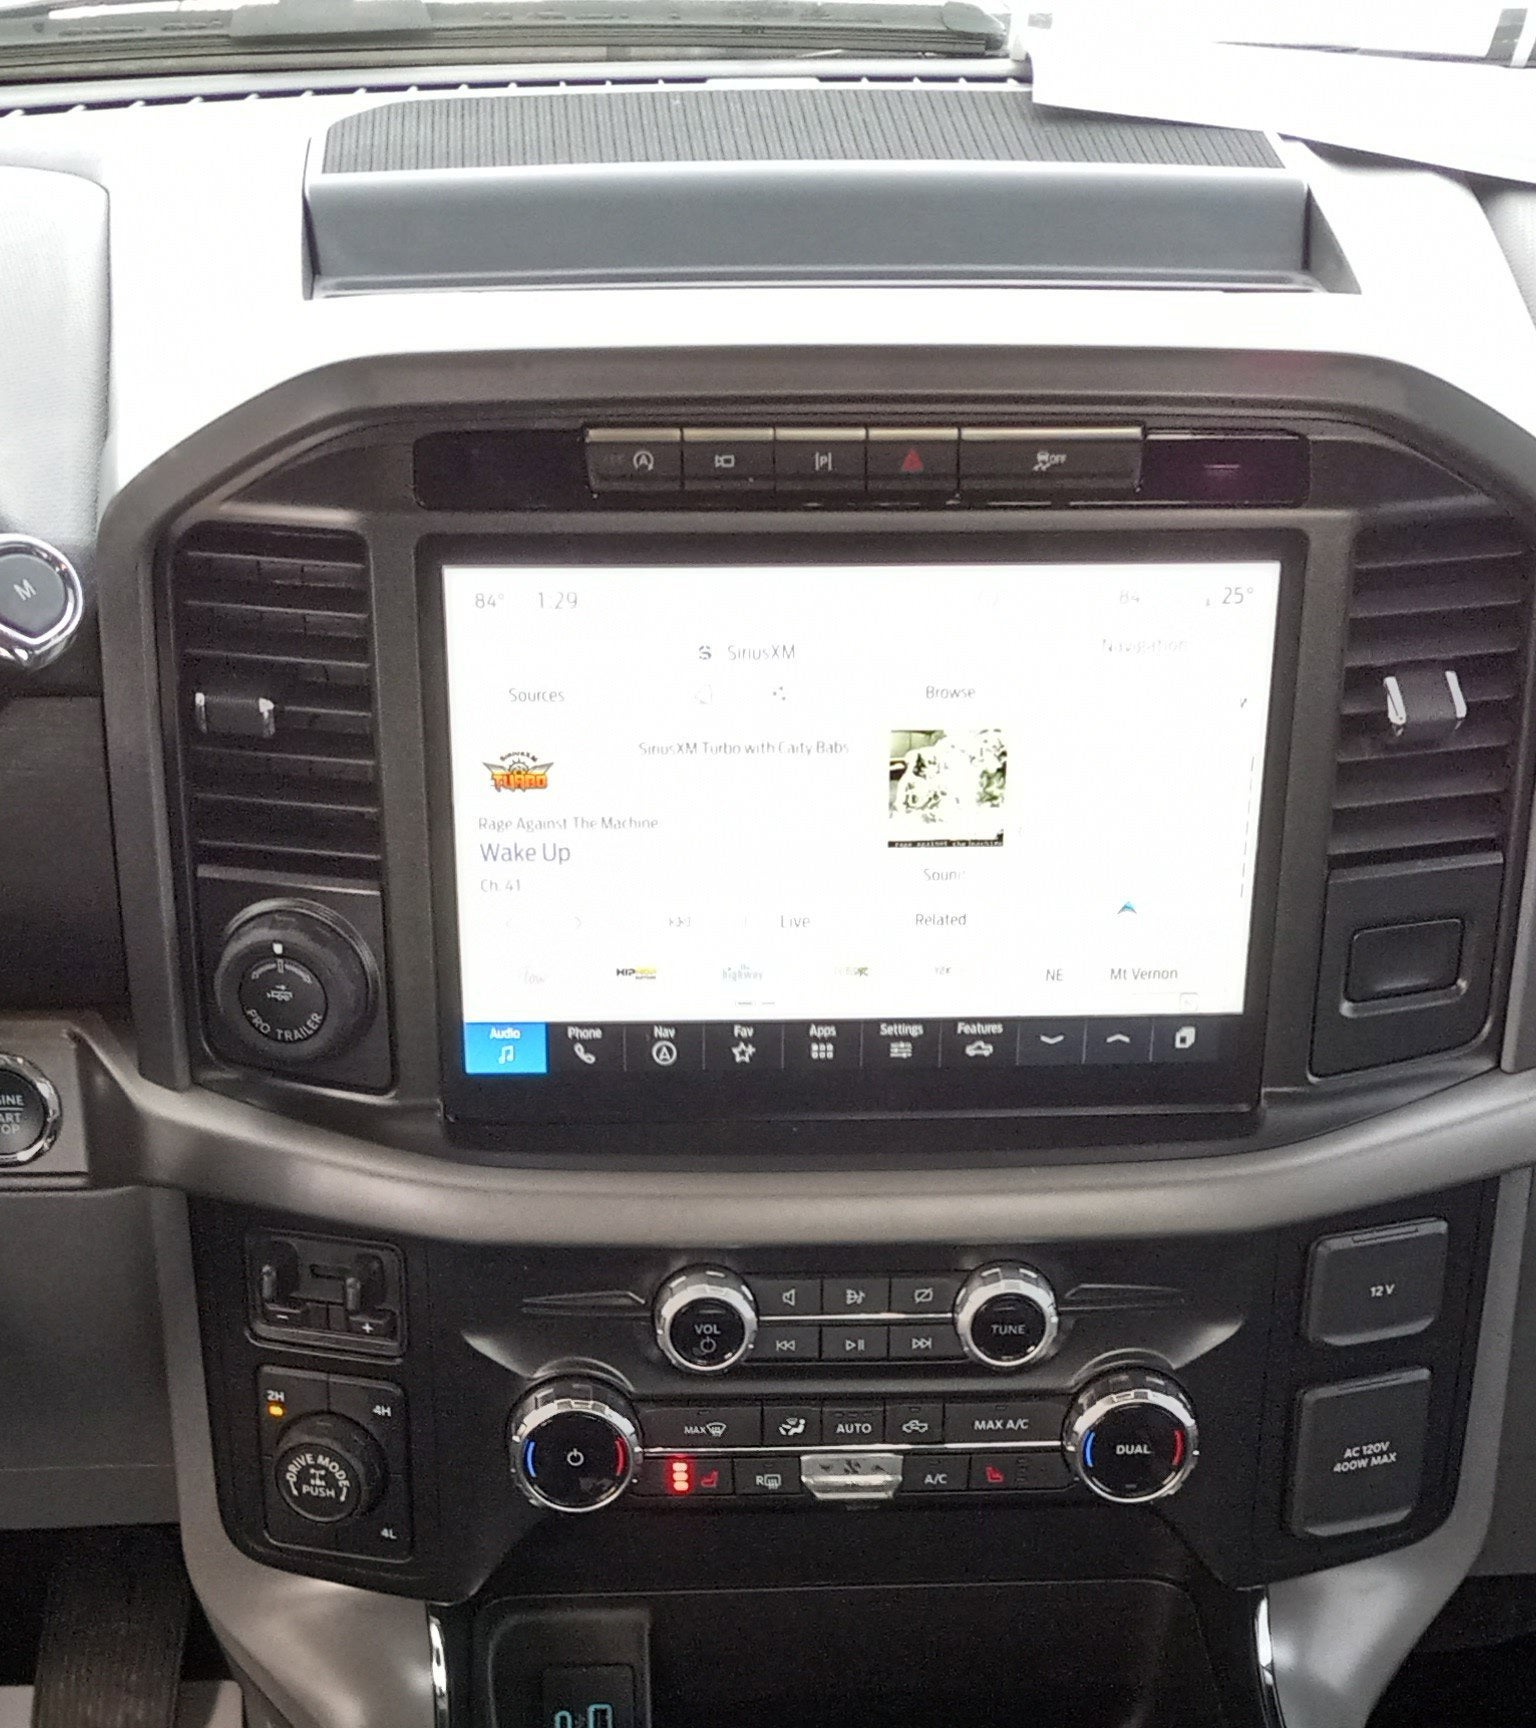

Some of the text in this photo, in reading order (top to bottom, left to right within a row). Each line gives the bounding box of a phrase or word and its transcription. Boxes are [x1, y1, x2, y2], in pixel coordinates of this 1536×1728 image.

[13, 579, 36, 601] M
[1222, 587, 1254, 605] 25°
[727, 643, 797, 661] SiriusXM
[508, 687, 565, 703] Sources
[925, 685, 976, 700] Browse
[638, 741, 698, 756] SiriusXM
[703, 741, 741, 756] Turbo
[744, 741, 775, 756] with
[816, 740, 850, 755] Babs
[490, 773, 548, 791] TURBO
[478, 815, 659, 833] Rage Against The Machine
[480, 842, 571, 866] Wake Up
[505, 879, 521, 892] 41
[779, 915, 811, 929] Live
[914, 912, 967, 927] Related
[1045, 968, 1064, 983] NE
[1110, 966, 1178, 981] Mt Vernon
[245, 1008, 324, 1042] PRO TRAILER
[879, 1023, 924, 1038] Settings
[956, 1021, 1004, 1036] Features
[489, 1027, 521, 1040] Audio
[567, 1026, 602, 1040] Phone
[653, 1026, 676, 1040] Nav
[733, 1026, 754, 1040] Fav
[808, 1025, 836, 1041] Apps
[1370, 1283, 1397, 1298] 12 V
[694, 1324, 722, 1335] VOL
[990, 1324, 1026, 1335] TUNE
[267, 1389, 285, 1402] 2H
[372, 1404, 392, 1417] 4H
[684, 1424, 706, 1436] MAX
[835, 1423, 872, 1434] AUTO
[974, 1419, 1029, 1431] MAX A/C
[1115, 1444, 1151, 1456] DUAL
[1343, 1440, 1391, 1460] AC 120V
[285, 1453, 351, 1488] DRIVE MODE
[1332, 1452, 1397, 1474] 400W MAX
[924, 1474, 948, 1486] A/C
[301, 1484, 336, 1499] PUSH
[380, 1528, 398, 1540] 4L
